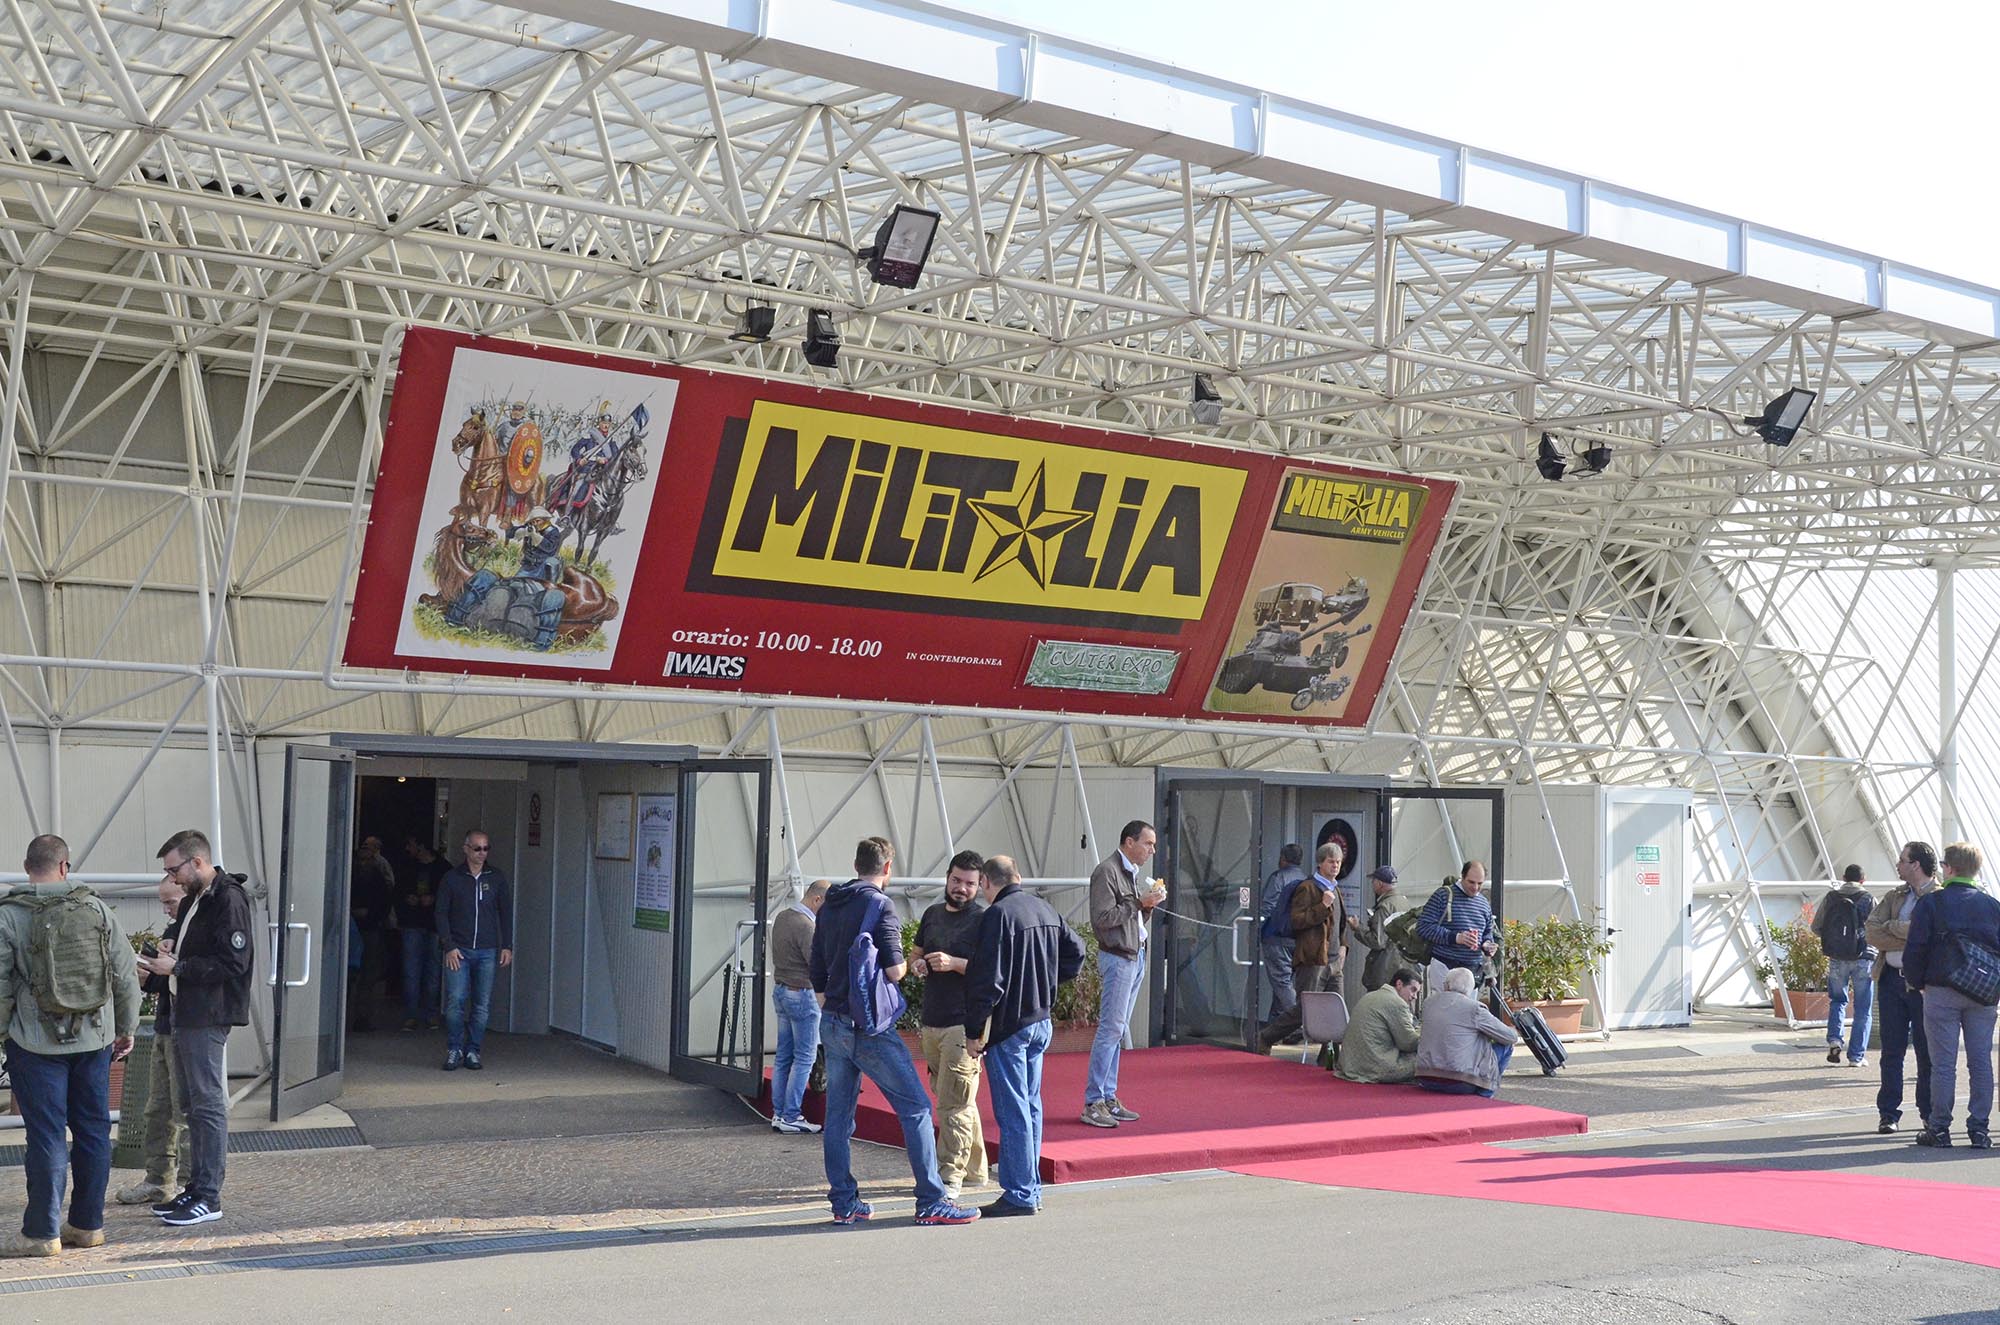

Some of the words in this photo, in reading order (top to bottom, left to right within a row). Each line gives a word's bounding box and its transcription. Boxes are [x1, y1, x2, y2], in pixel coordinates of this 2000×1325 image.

[1350, 526, 1372, 536] ARMY
[1373, 528, 1406, 539] VEHICLES
[671, 628, 750, 648] orario:
[755, 631, 811, 652] 10.00
[829, 637, 883, 658] 18.00
[906, 652, 918, 660] IN
[919, 653, 1003, 667] CONTEMPORANEA
[1050, 650, 1116, 670] CULTER
[1121, 656, 1162, 674] EXPO
